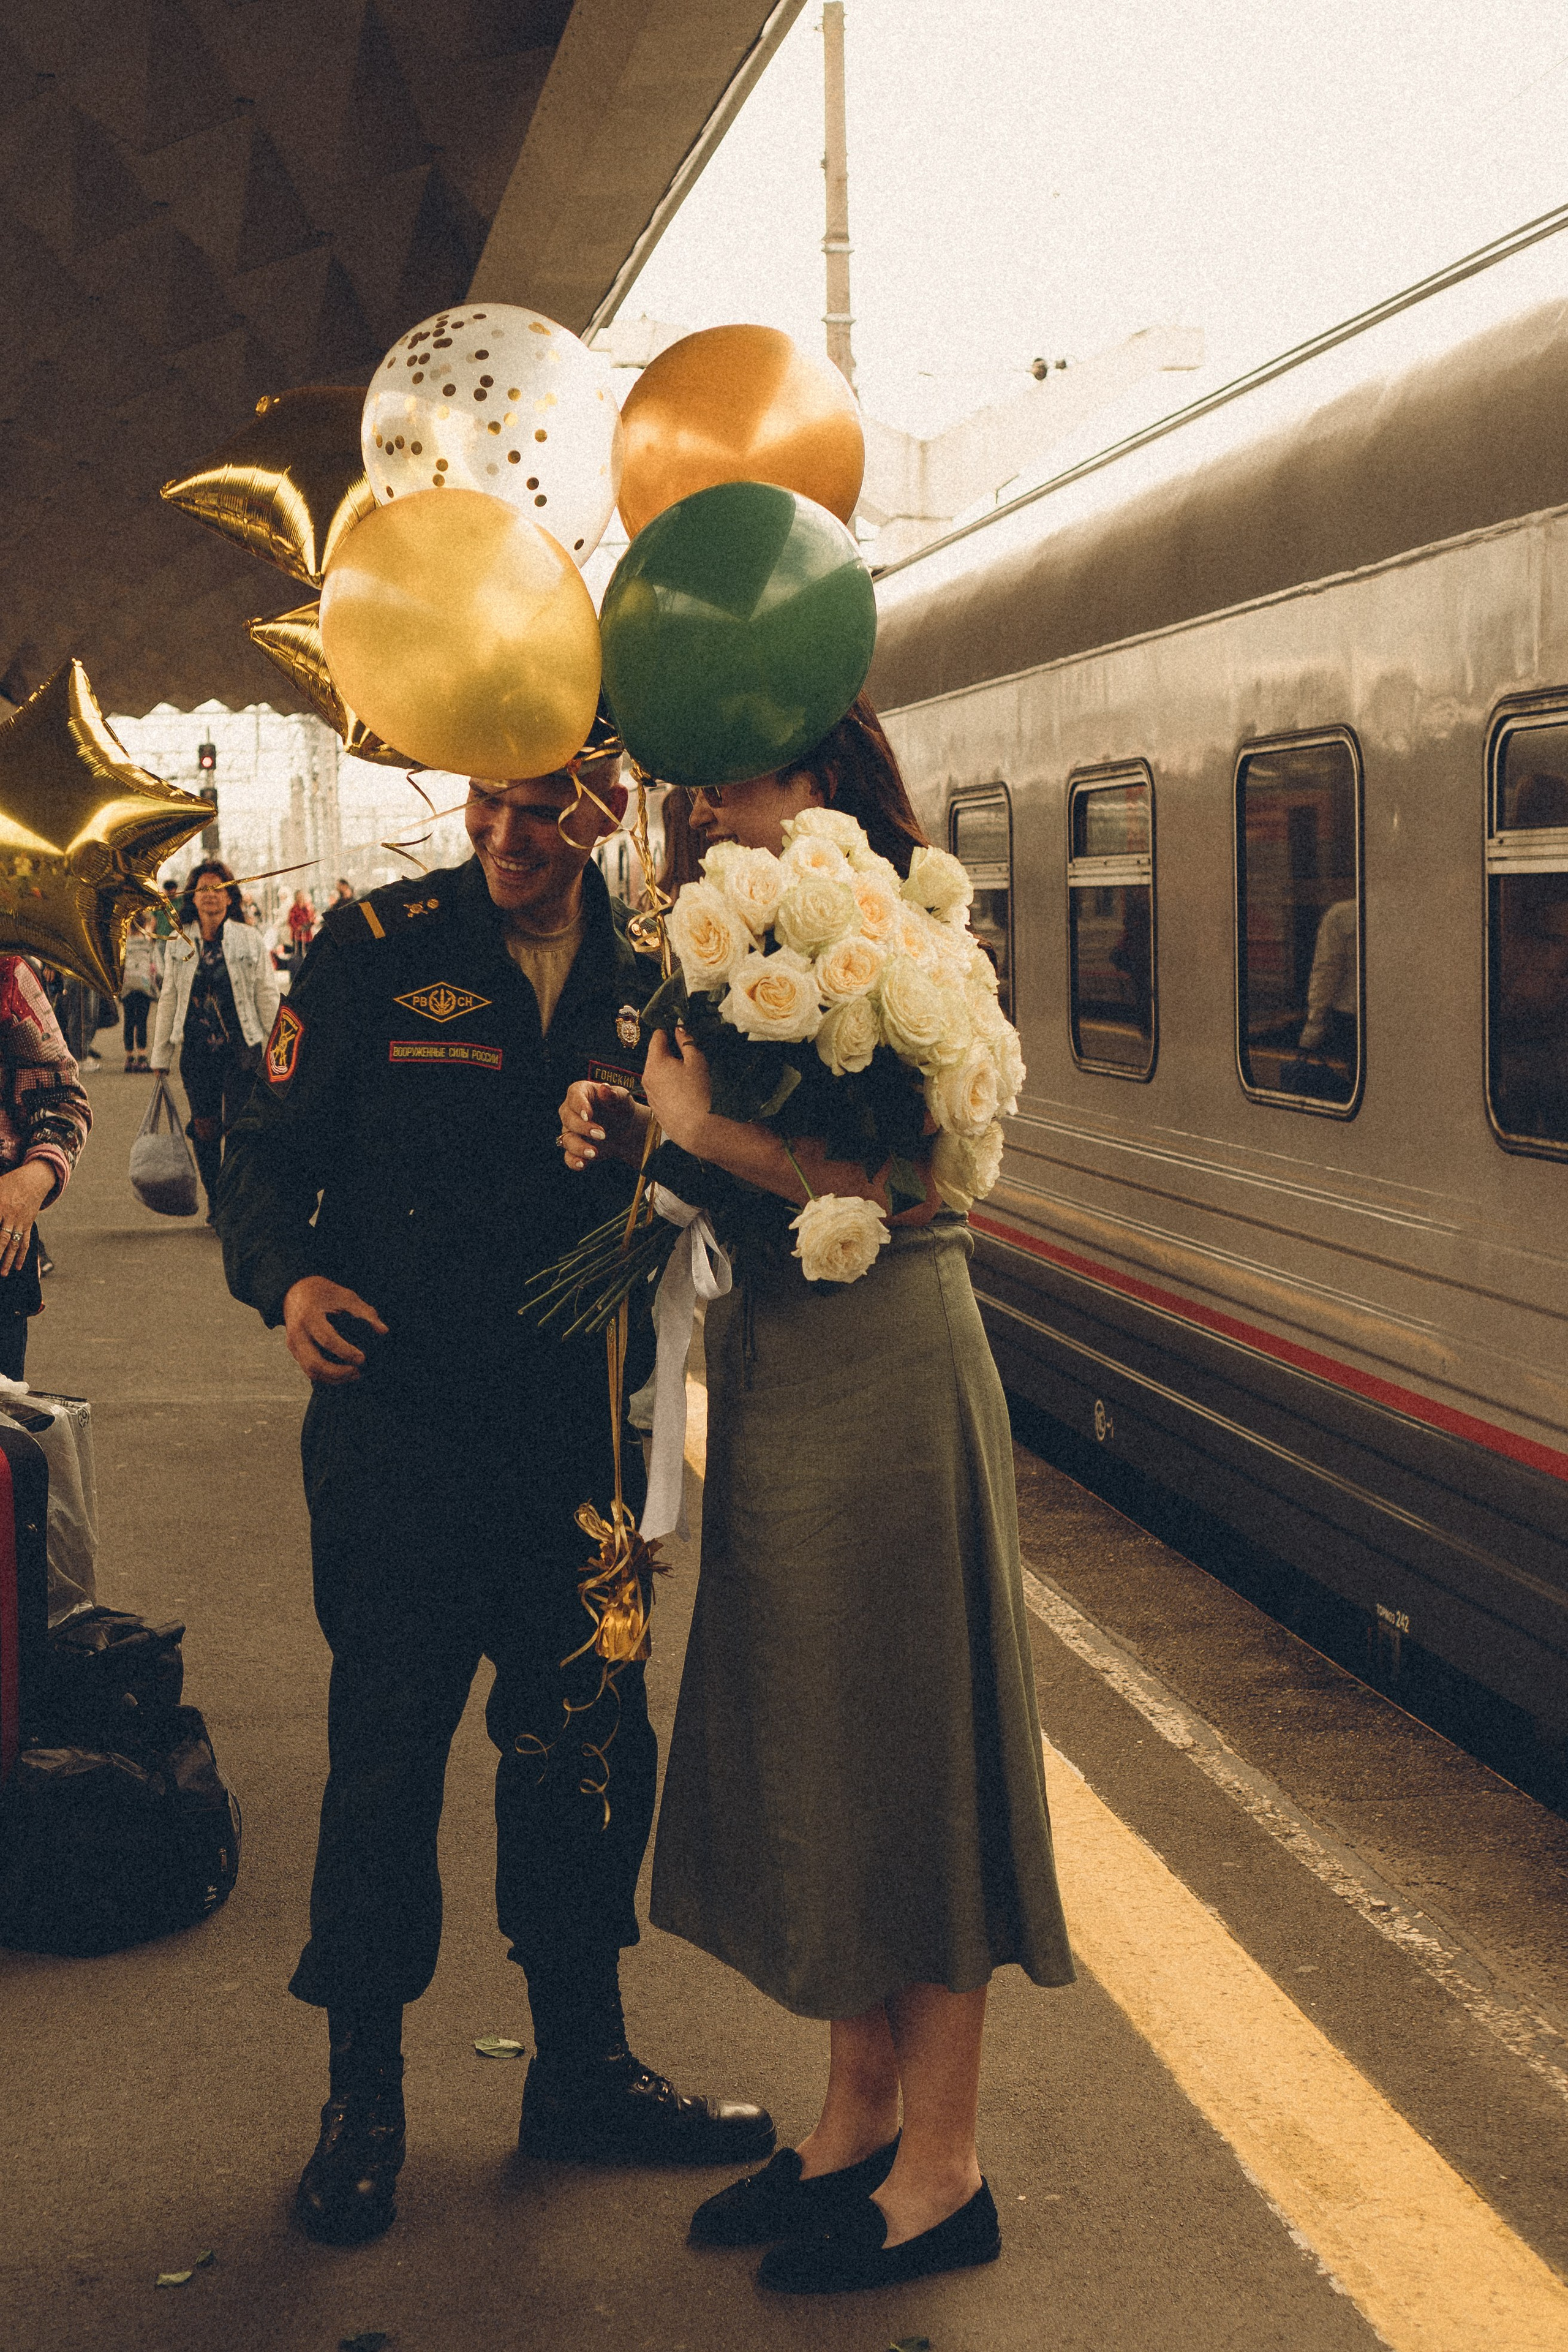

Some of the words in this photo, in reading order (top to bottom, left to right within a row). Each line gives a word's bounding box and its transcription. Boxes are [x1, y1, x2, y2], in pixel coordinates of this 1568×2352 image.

[393, 1046, 446, 1057] ВООРУЖЕННЫЕ
[448, 1047, 469, 1058] СИЛЫ
[472, 1049, 499, 1065] РОССИИ
[595, 1068, 635, 1088] ГОНСКИЙ
[1396, 1610, 1410, 1633] 242
